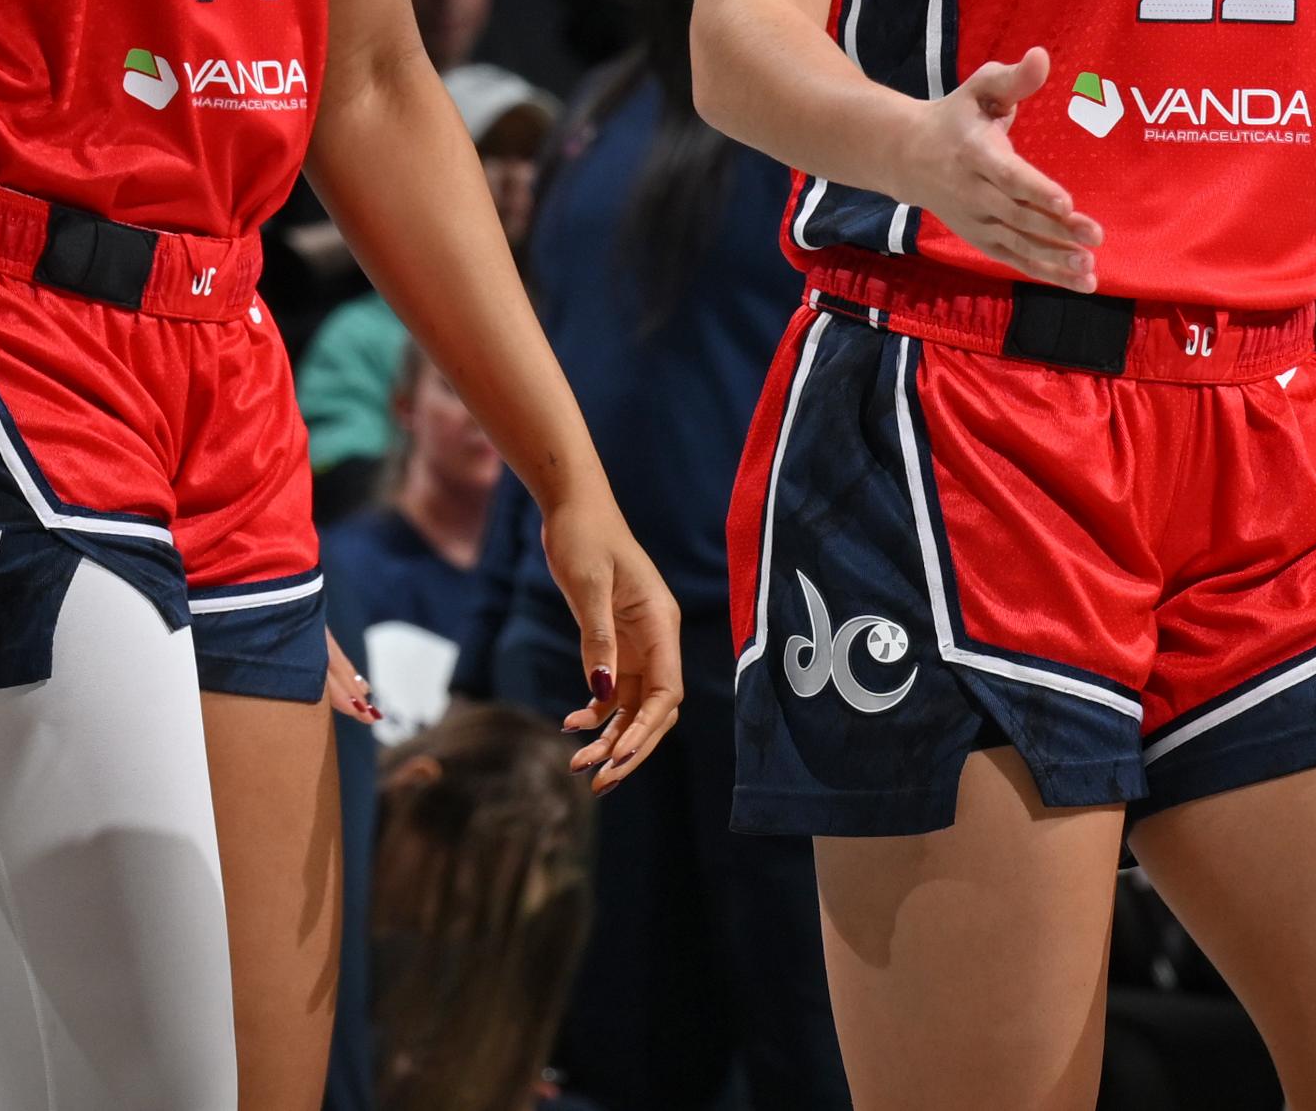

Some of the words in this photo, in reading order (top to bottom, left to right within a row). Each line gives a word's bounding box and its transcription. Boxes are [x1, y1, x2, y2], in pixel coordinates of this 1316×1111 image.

[183, 58, 308, 95] VANDA
[1130, 87, 1312, 127] VANDA
[1144, 129, 1294, 143] PHARMACEUTICALS
